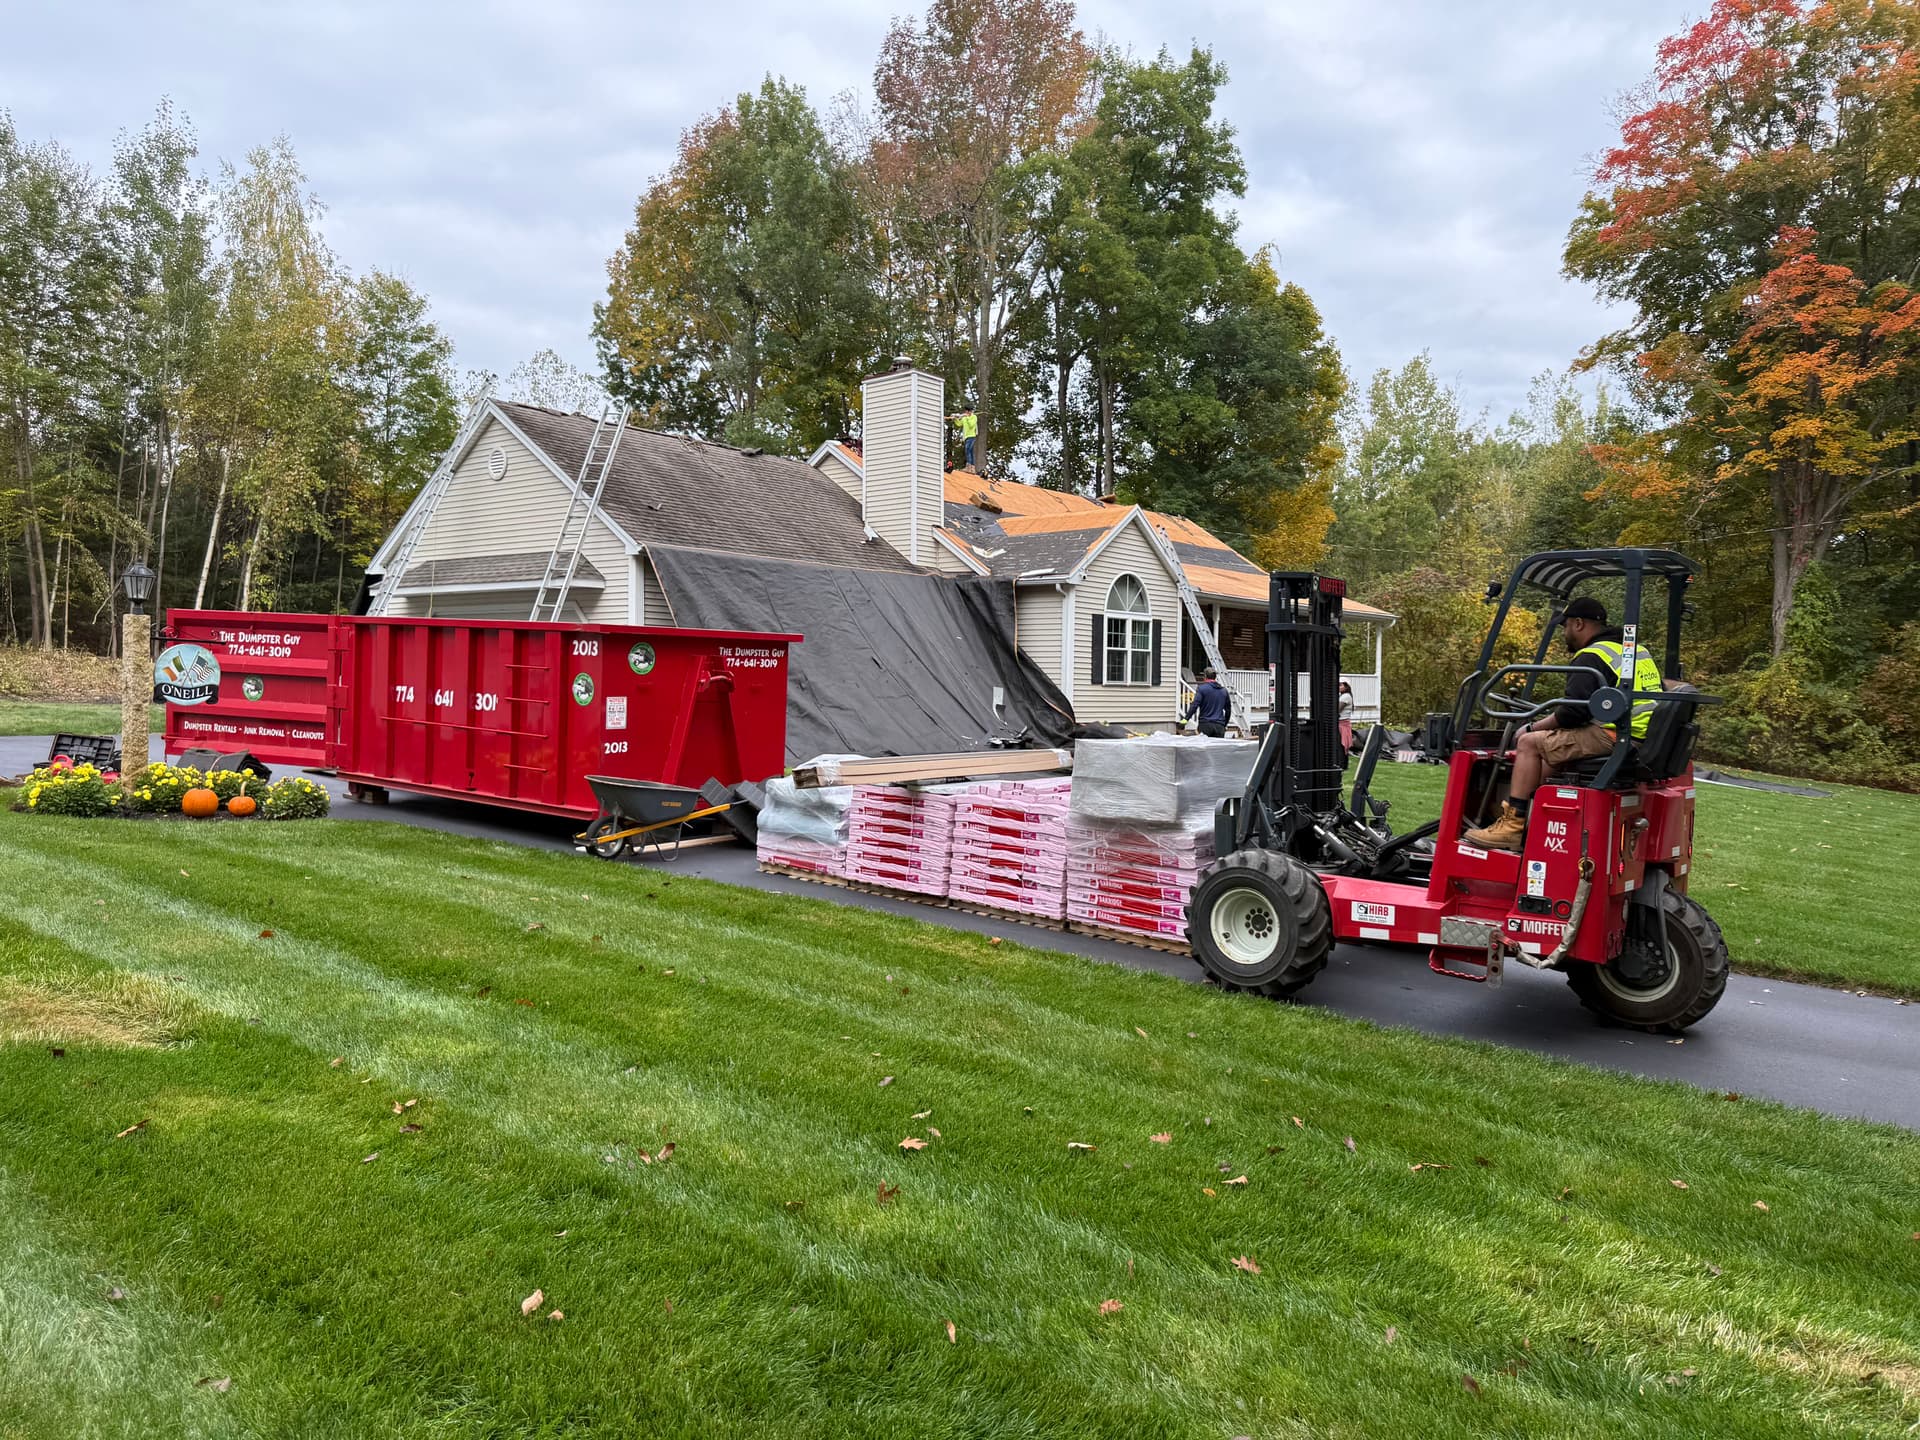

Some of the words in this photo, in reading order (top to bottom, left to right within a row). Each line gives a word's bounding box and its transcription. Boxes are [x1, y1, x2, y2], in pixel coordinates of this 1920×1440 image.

[220, 631, 235, 642] THE
[238, 632, 281, 644] DUMPSTER
[284, 634, 301, 645] GUY
[229, 645, 291, 657] 774-641-3019
[573, 640, 598, 656] 2013
[719, 646, 733, 656] THE
[735, 647, 769, 657] DUMPSTER
[772, 648, 785, 657] GUY
[726, 658, 778, 668] 774-641-3019
[161, 684, 213, 699] O'NEILL
[396, 686, 414, 703] 774
[434, 689, 454, 707] 641
[475, 693, 498, 711] 301
[184, 721, 212, 731] DUMPSTER
[213, 723, 237, 733] RENTALS
[244, 726, 257, 735] JUNK
[259, 727, 285, 737] REMOVAL
[292, 729, 324, 740] CLEANOUTS
[604, 741, 628, 754] 2013
[1547, 821, 1567, 836] M5
[1544, 836, 1566, 852] NX
[1369, 905, 1389, 916] HIAB
[1523, 920, 1567, 936] MOFFET
